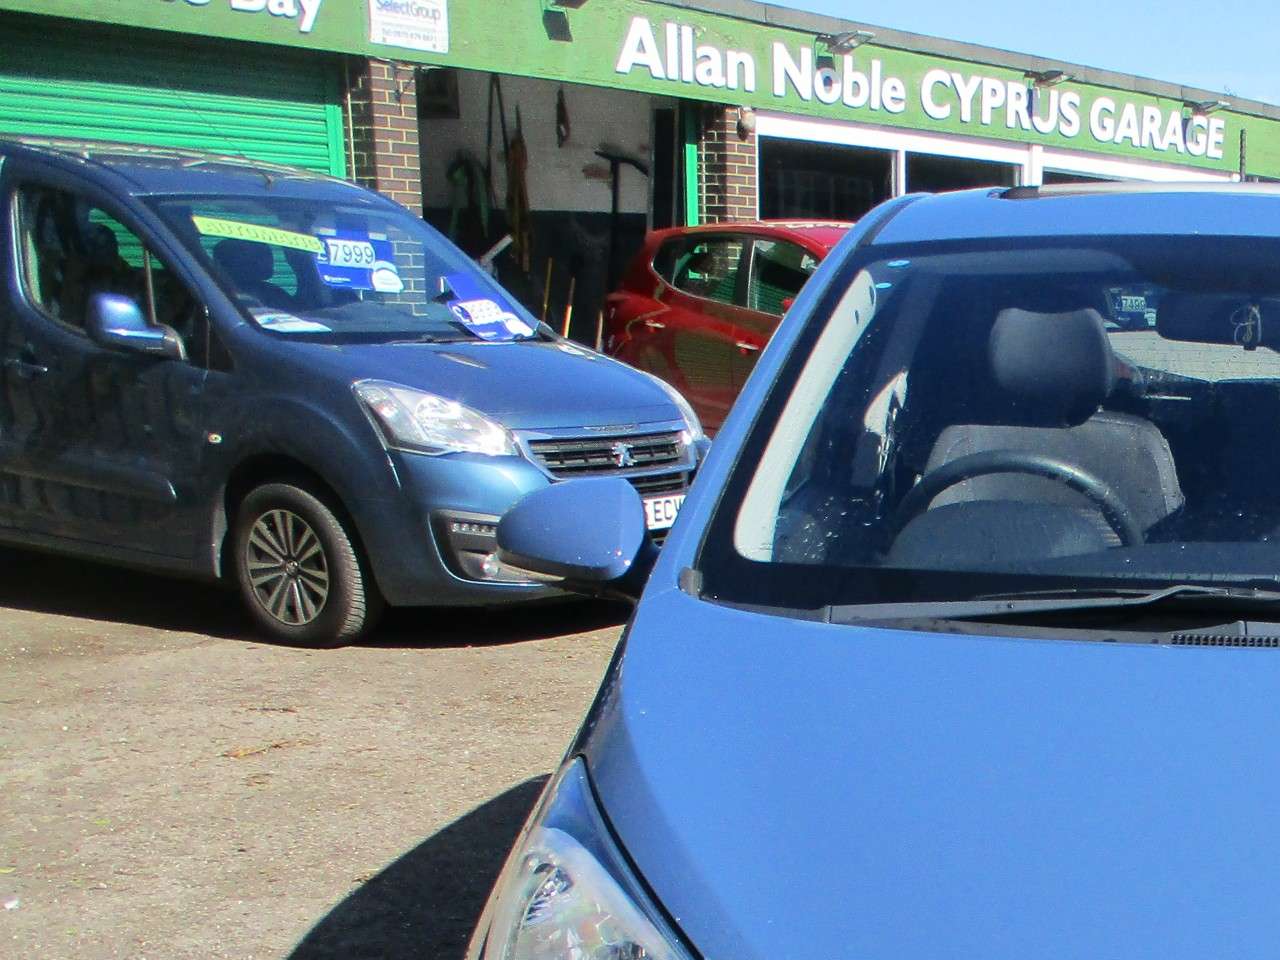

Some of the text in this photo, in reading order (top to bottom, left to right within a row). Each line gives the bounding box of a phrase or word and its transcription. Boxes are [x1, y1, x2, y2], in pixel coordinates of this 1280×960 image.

[230, 0, 322, 33] ay
[615, 16, 1225, 159] Allan Noble CYPRUS GARAGE
